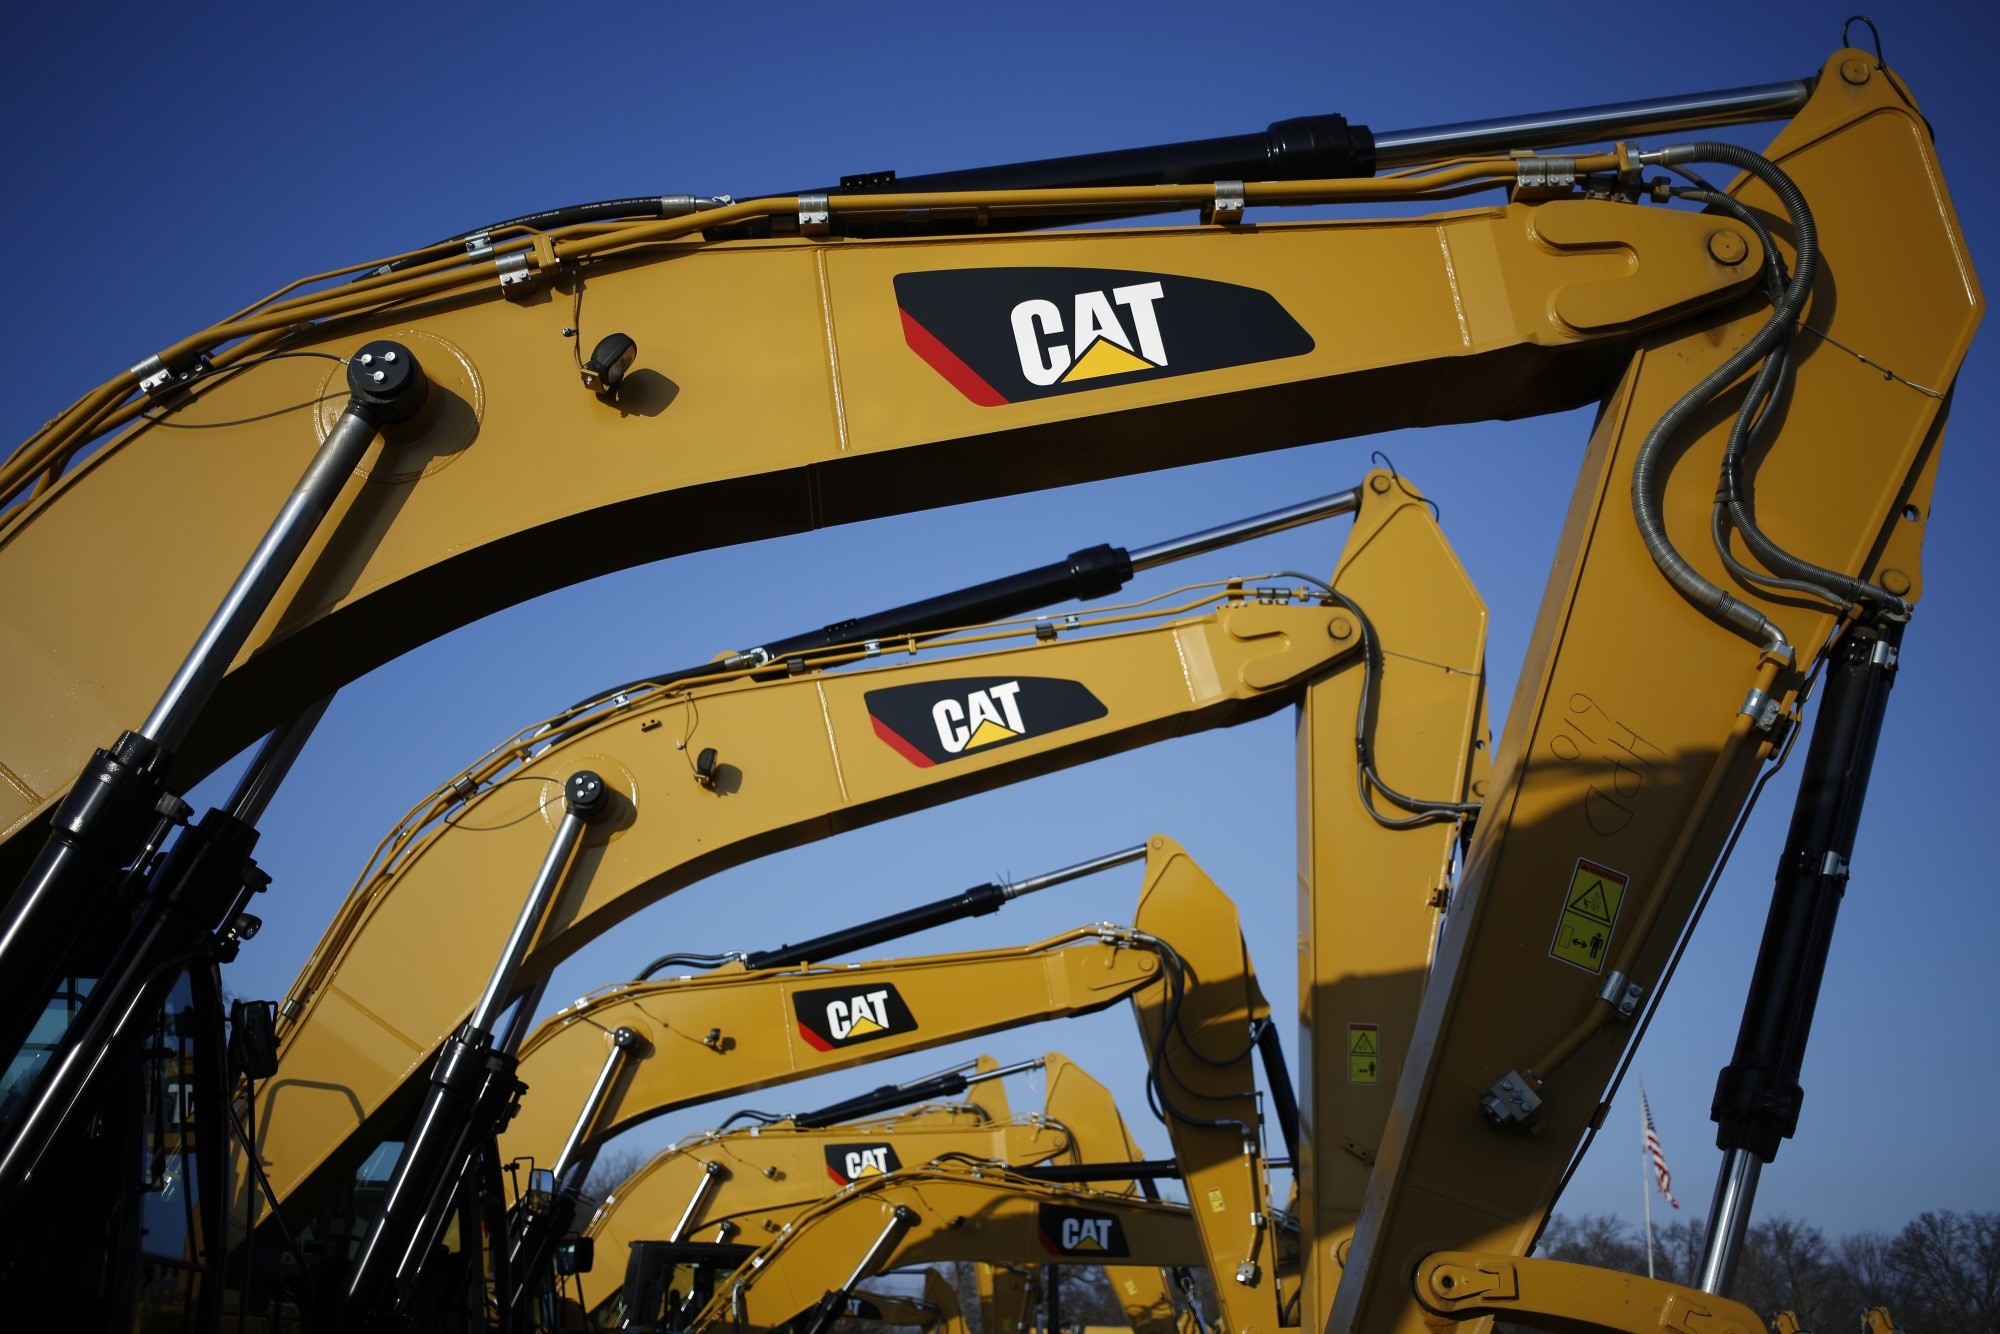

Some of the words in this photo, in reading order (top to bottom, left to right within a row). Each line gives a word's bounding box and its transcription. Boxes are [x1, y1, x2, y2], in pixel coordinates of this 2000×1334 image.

[1010, 280, 1169, 386] CAT
[931, 680, 1026, 754] CAT
[826, 989, 890, 1040] CAT
[845, 1147, 888, 1179] CAT
[1062, 1217, 1113, 1250] CAT
